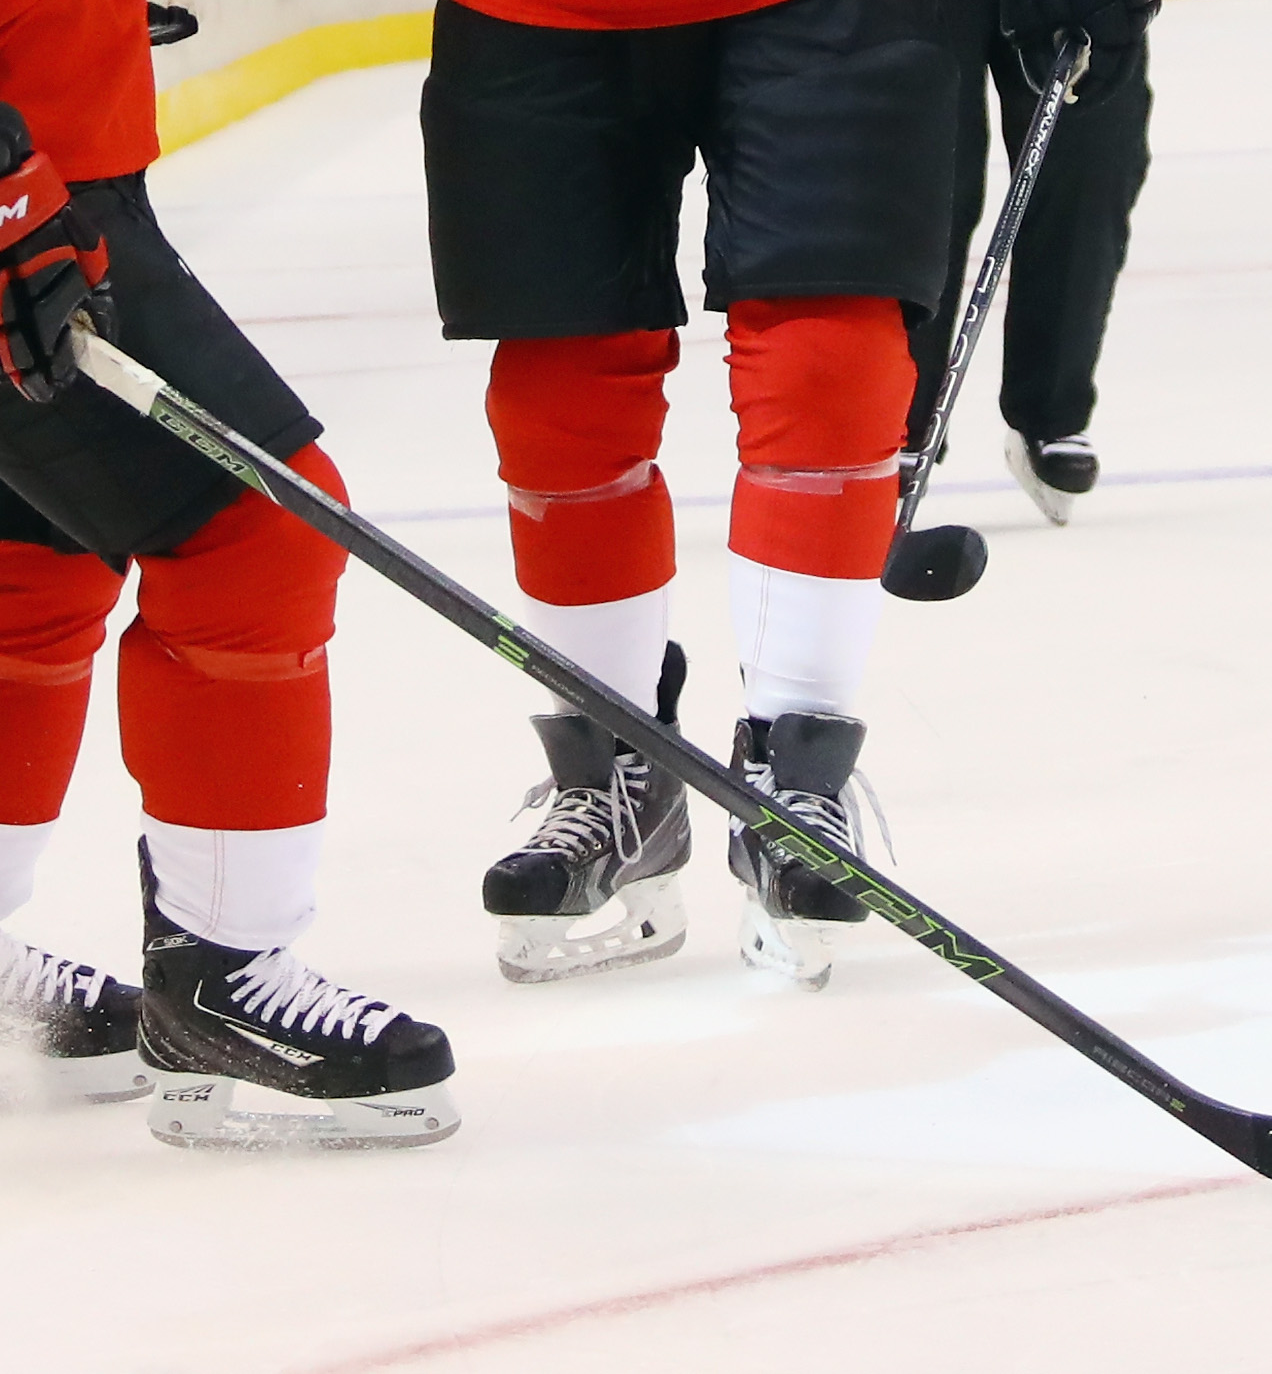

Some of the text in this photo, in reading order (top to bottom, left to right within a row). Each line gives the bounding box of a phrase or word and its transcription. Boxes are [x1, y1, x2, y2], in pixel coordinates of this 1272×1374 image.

[157, 408, 247, 473] CCM
[751, 806, 1005, 982] CCM
[271, 1043, 312, 1061] CCM
[163, 1093, 210, 1102] CCM
